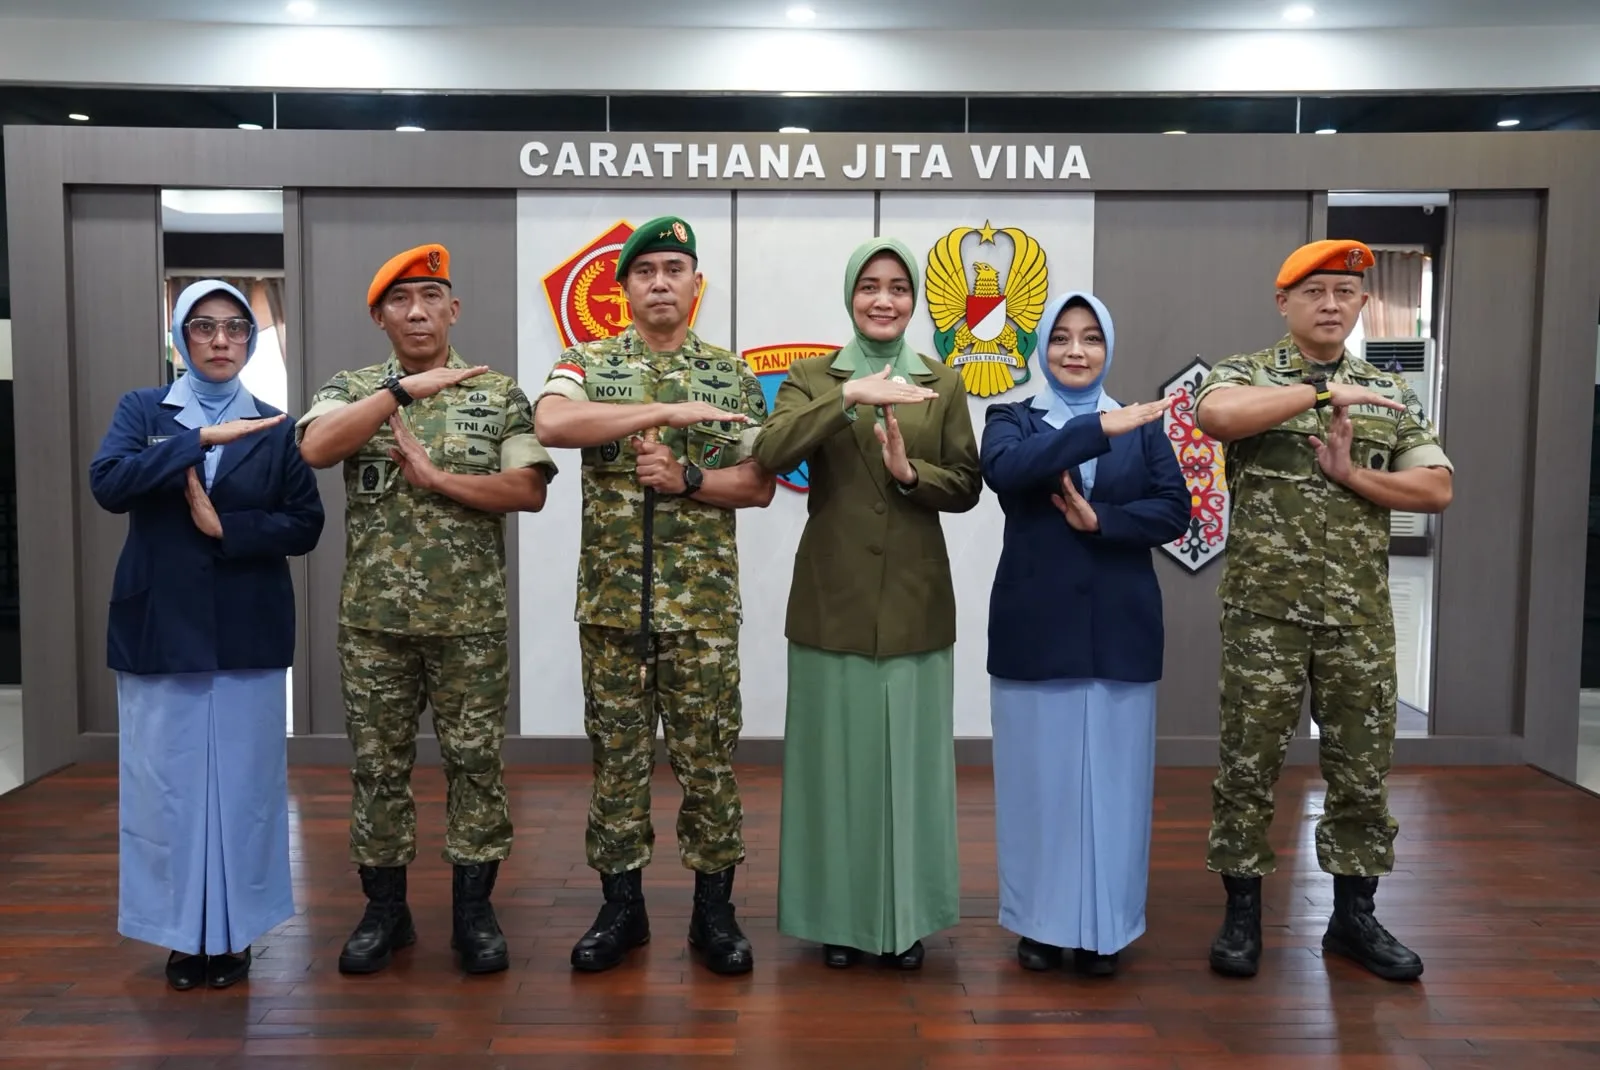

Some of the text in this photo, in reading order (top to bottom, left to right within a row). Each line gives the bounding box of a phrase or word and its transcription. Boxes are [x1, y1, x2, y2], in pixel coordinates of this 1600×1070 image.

[519, 141, 1091, 179] CARATHANA JITA VINA
[596, 386, 632, 397] NOVI
[692, 391, 739, 409] TNI AD
[454, 421, 499, 436] TNI AU
